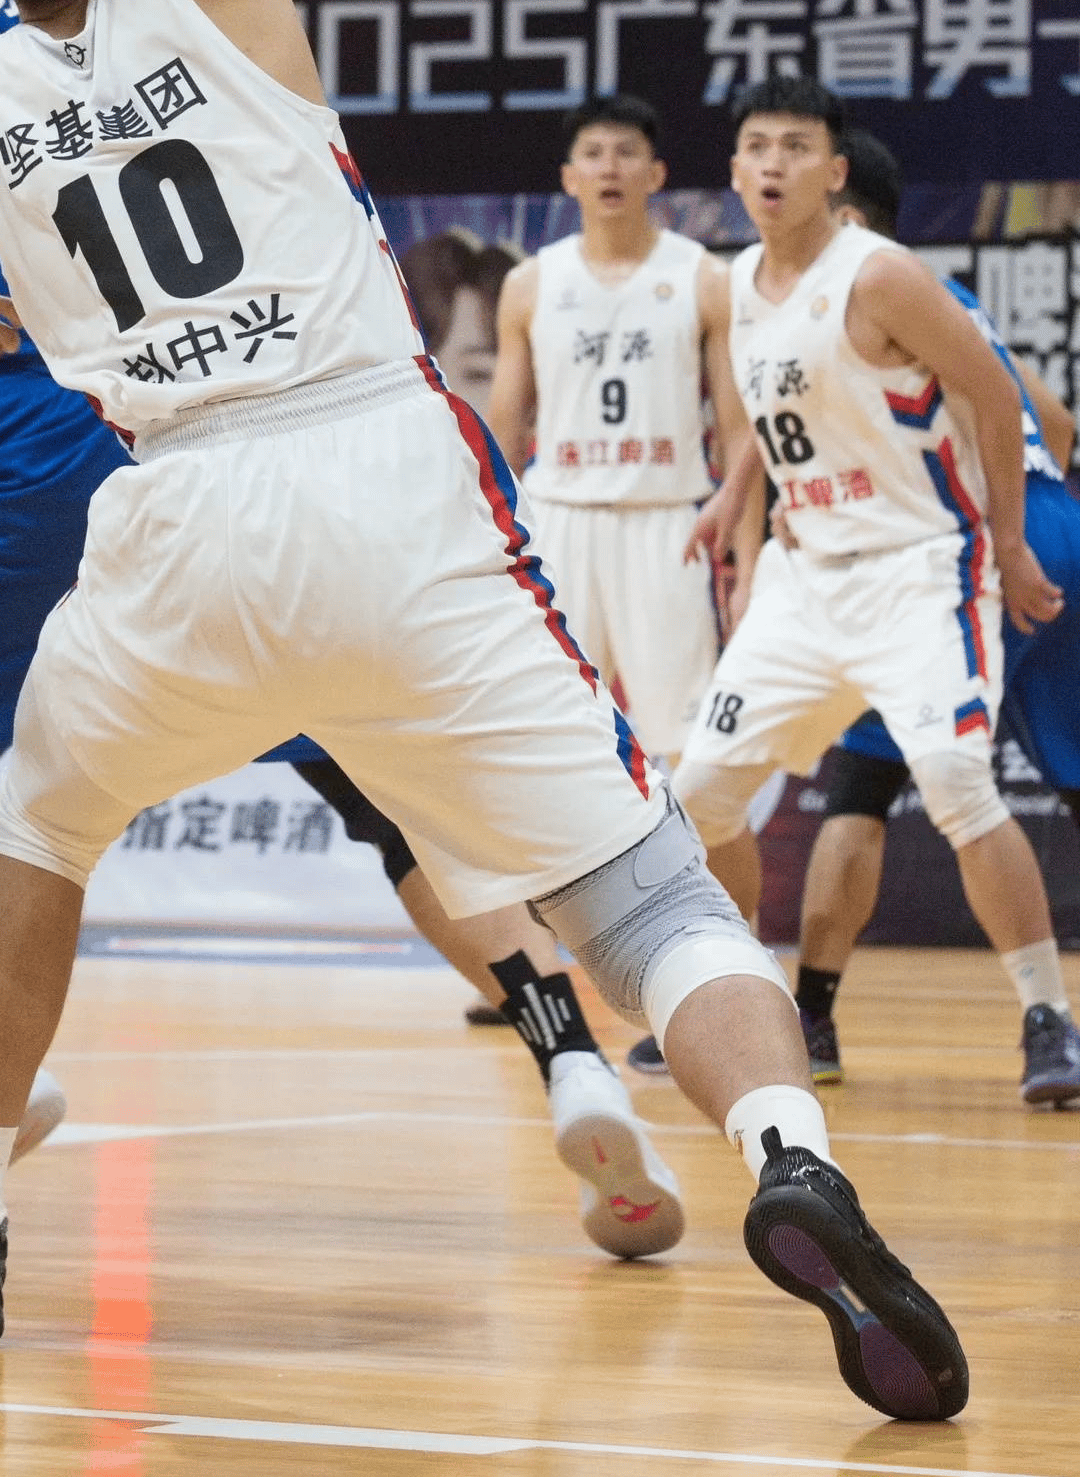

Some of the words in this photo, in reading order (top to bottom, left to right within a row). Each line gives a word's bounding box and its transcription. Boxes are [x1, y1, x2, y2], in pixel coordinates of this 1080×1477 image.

[51, 138, 245, 333] 10
[574, 329, 653, 367] 河源
[601, 377, 627, 424] 9
[755, 410, 816, 465] 18
[706, 690, 745, 736] 18
